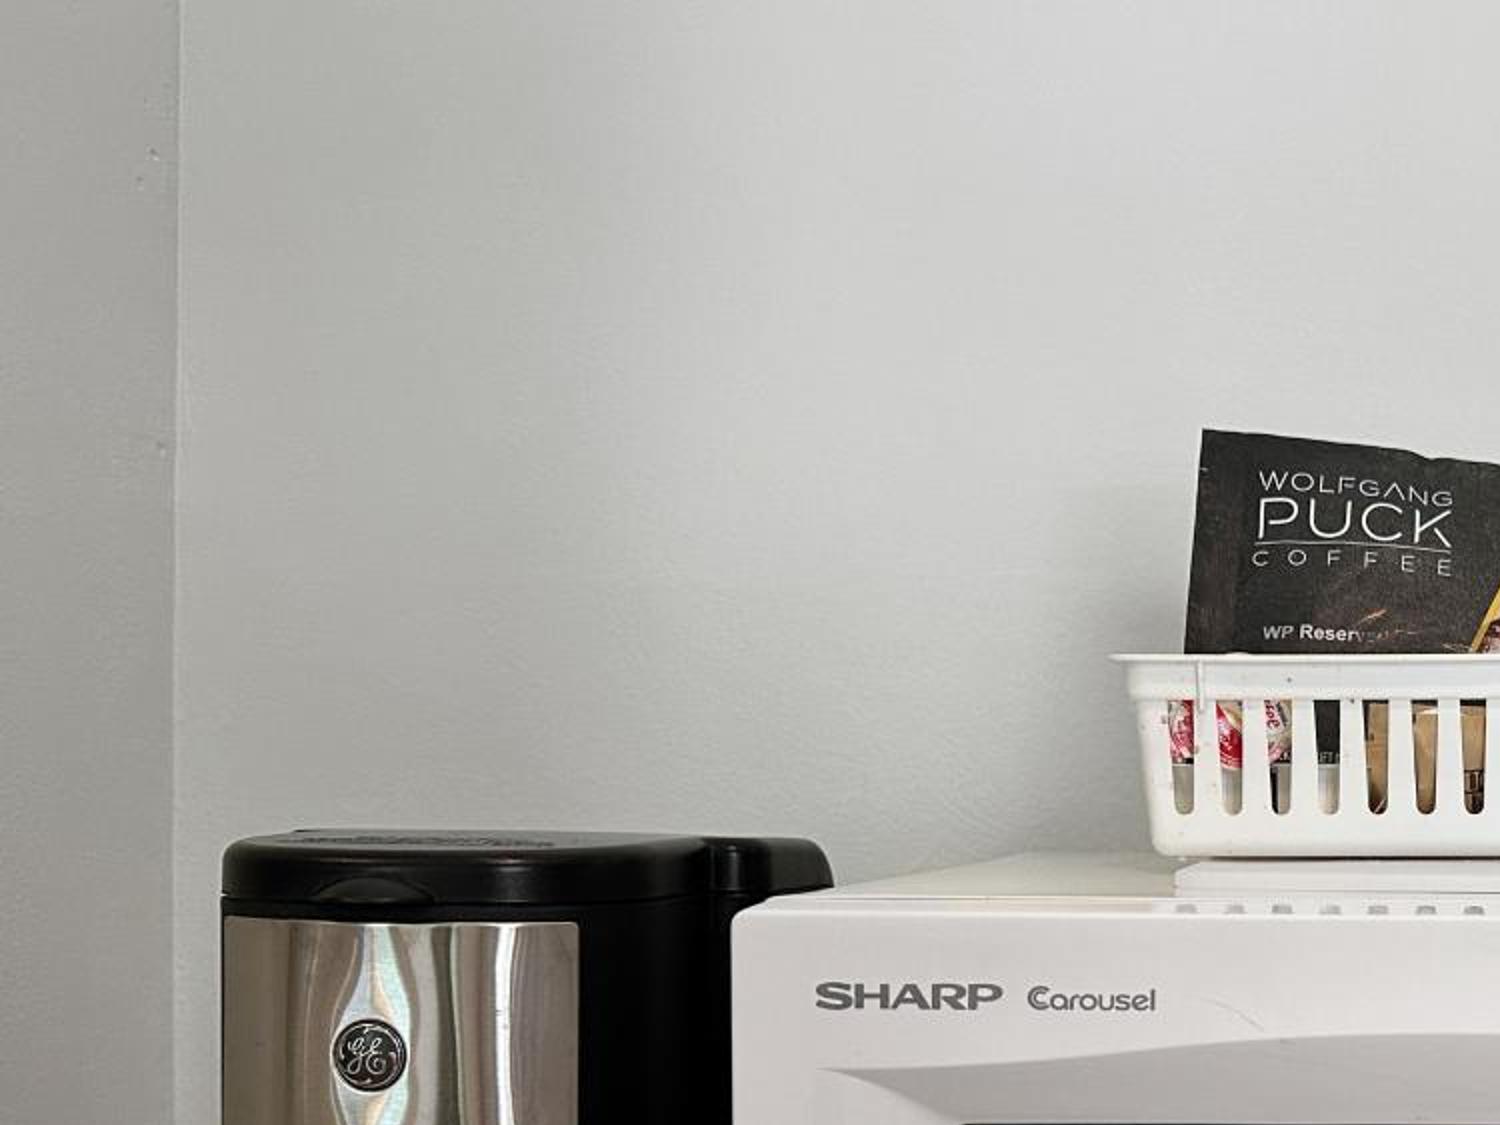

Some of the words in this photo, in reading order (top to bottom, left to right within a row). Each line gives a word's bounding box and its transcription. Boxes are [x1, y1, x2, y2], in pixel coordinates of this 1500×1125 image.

[1258, 470, 1453, 505] WOLFGANG
[1258, 498, 1452, 548] PUCK
[1252, 550, 1451, 577] COFFEE
[1263, 625, 1294, 640] WP
[815, 981, 1004, 1011] SHARP
[1027, 985, 1156, 1011] Carousel
